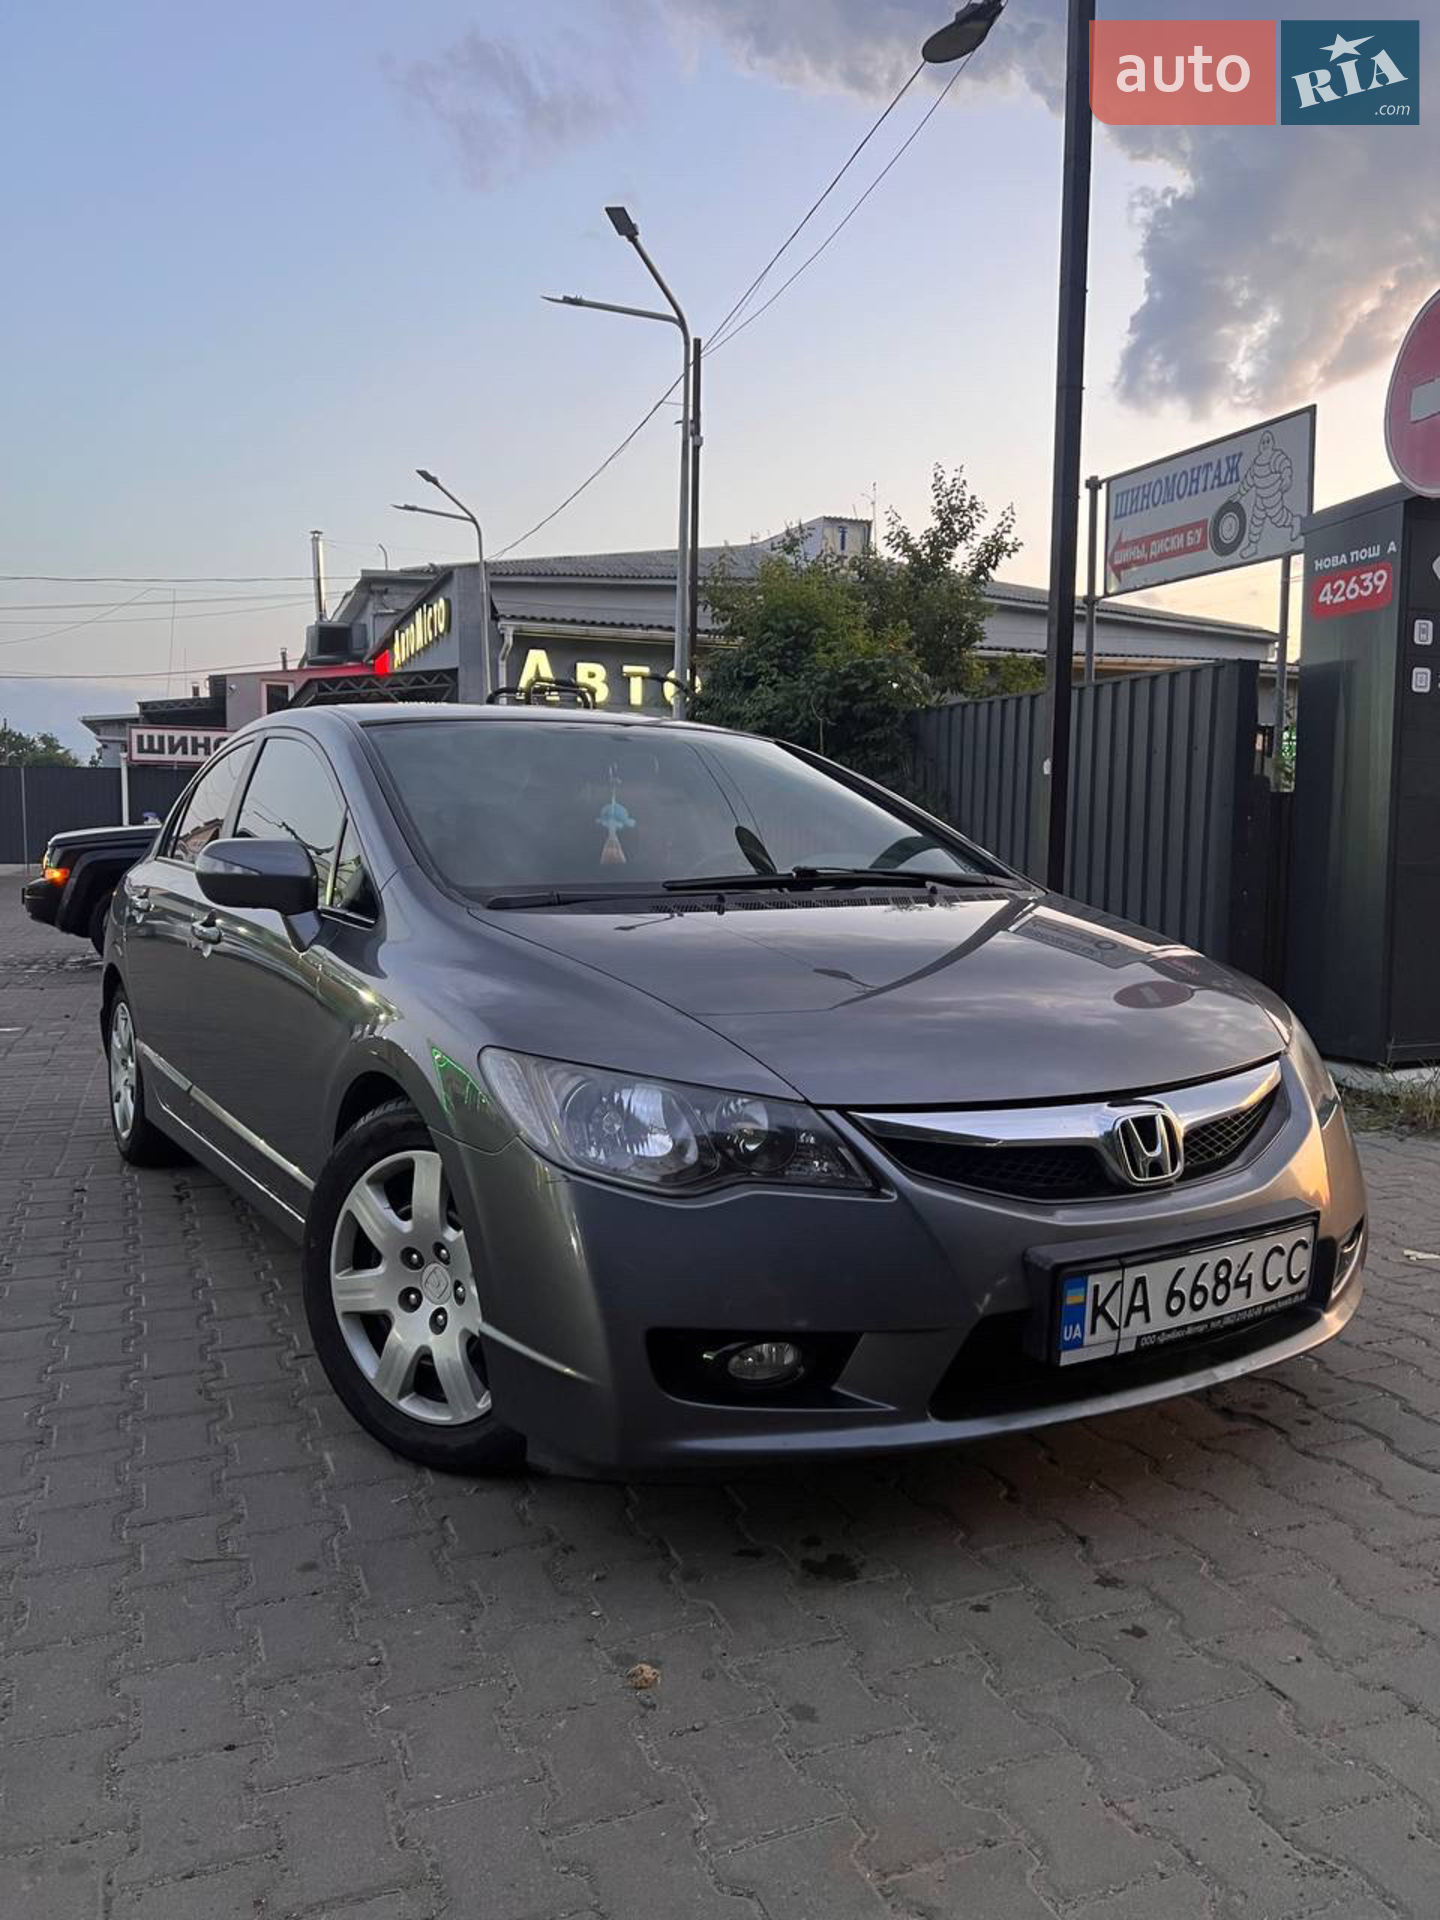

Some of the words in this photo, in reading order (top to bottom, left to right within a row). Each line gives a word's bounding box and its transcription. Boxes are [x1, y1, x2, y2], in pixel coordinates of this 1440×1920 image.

[1115, 453, 1242, 519] ШИНОМОНТАЖ
[1149, 533, 1185, 559] ДИСКИ
[1314, 553, 1348, 571] НОВА
[1317, 569, 1388, 606] 42639
[1091, 1276, 1151, 1335] KA
[1164, 1251, 1254, 1318] 6684
[1261, 1238, 1310, 1292] CC
[1062, 1323, 1083, 1342] UA
